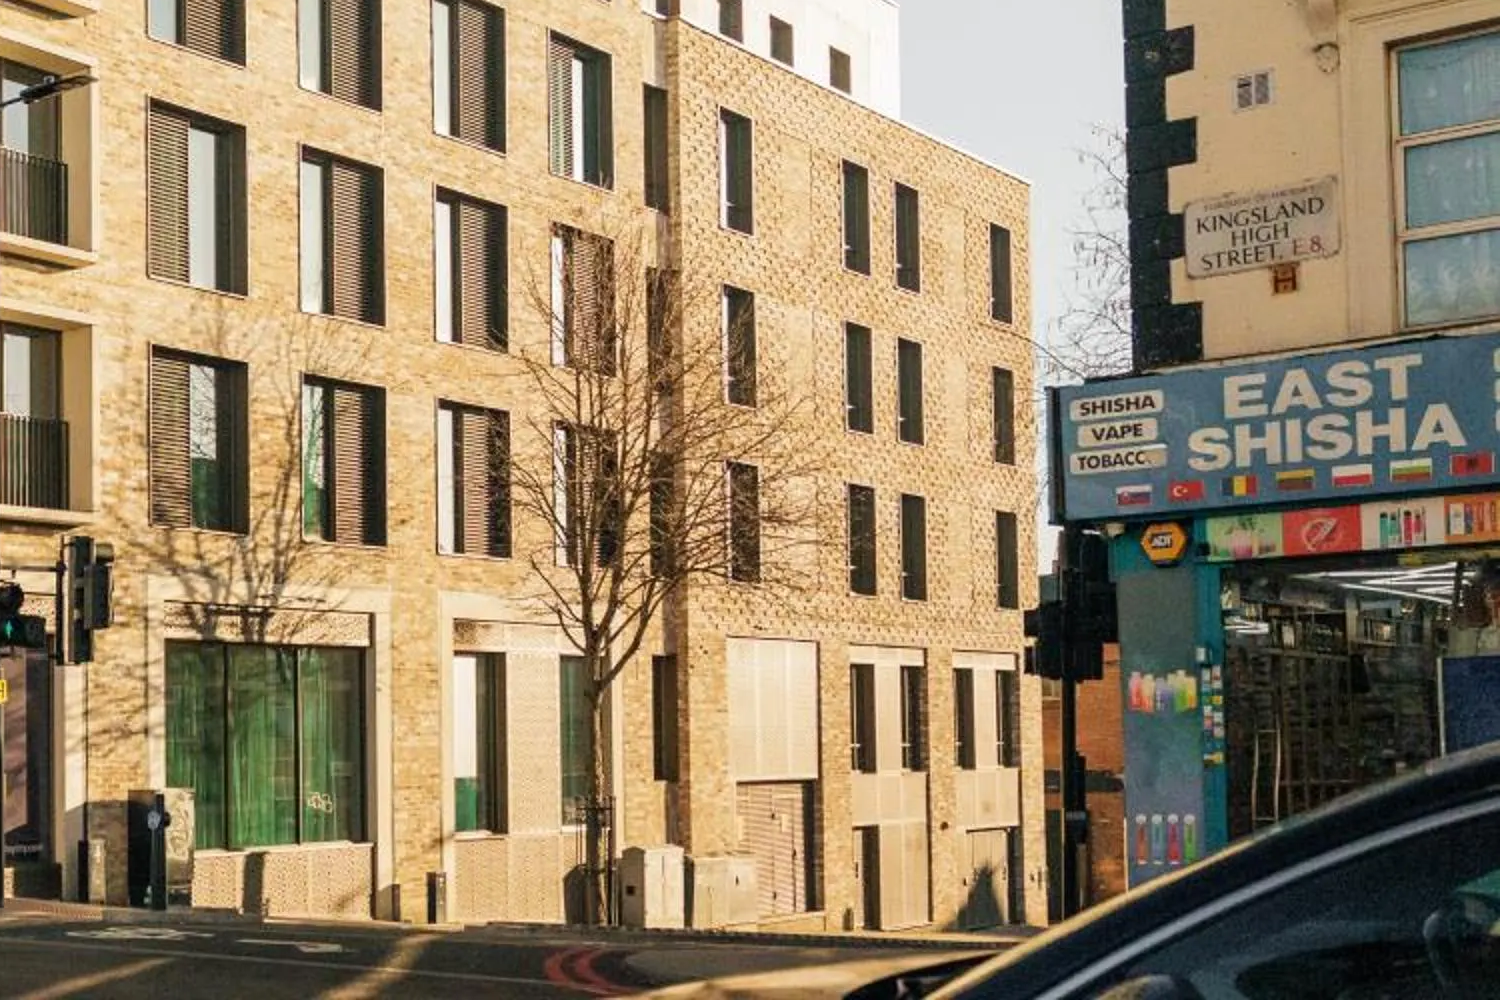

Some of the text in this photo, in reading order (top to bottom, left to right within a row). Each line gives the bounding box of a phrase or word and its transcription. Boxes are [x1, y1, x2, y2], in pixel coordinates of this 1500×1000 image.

[1196, 196, 1325, 234] KINGSLAND
[1231, 221, 1289, 247] HIGH
[1224, 353, 1422, 419] EAST
[1079, 394, 1156, 417] SHISHA
[1091, 423, 1143, 441] VAPE
[1187, 403, 1468, 472] SHISHA
[1077, 450, 1151, 471] TOBACC
[1151, 534, 1173, 548] ADT
